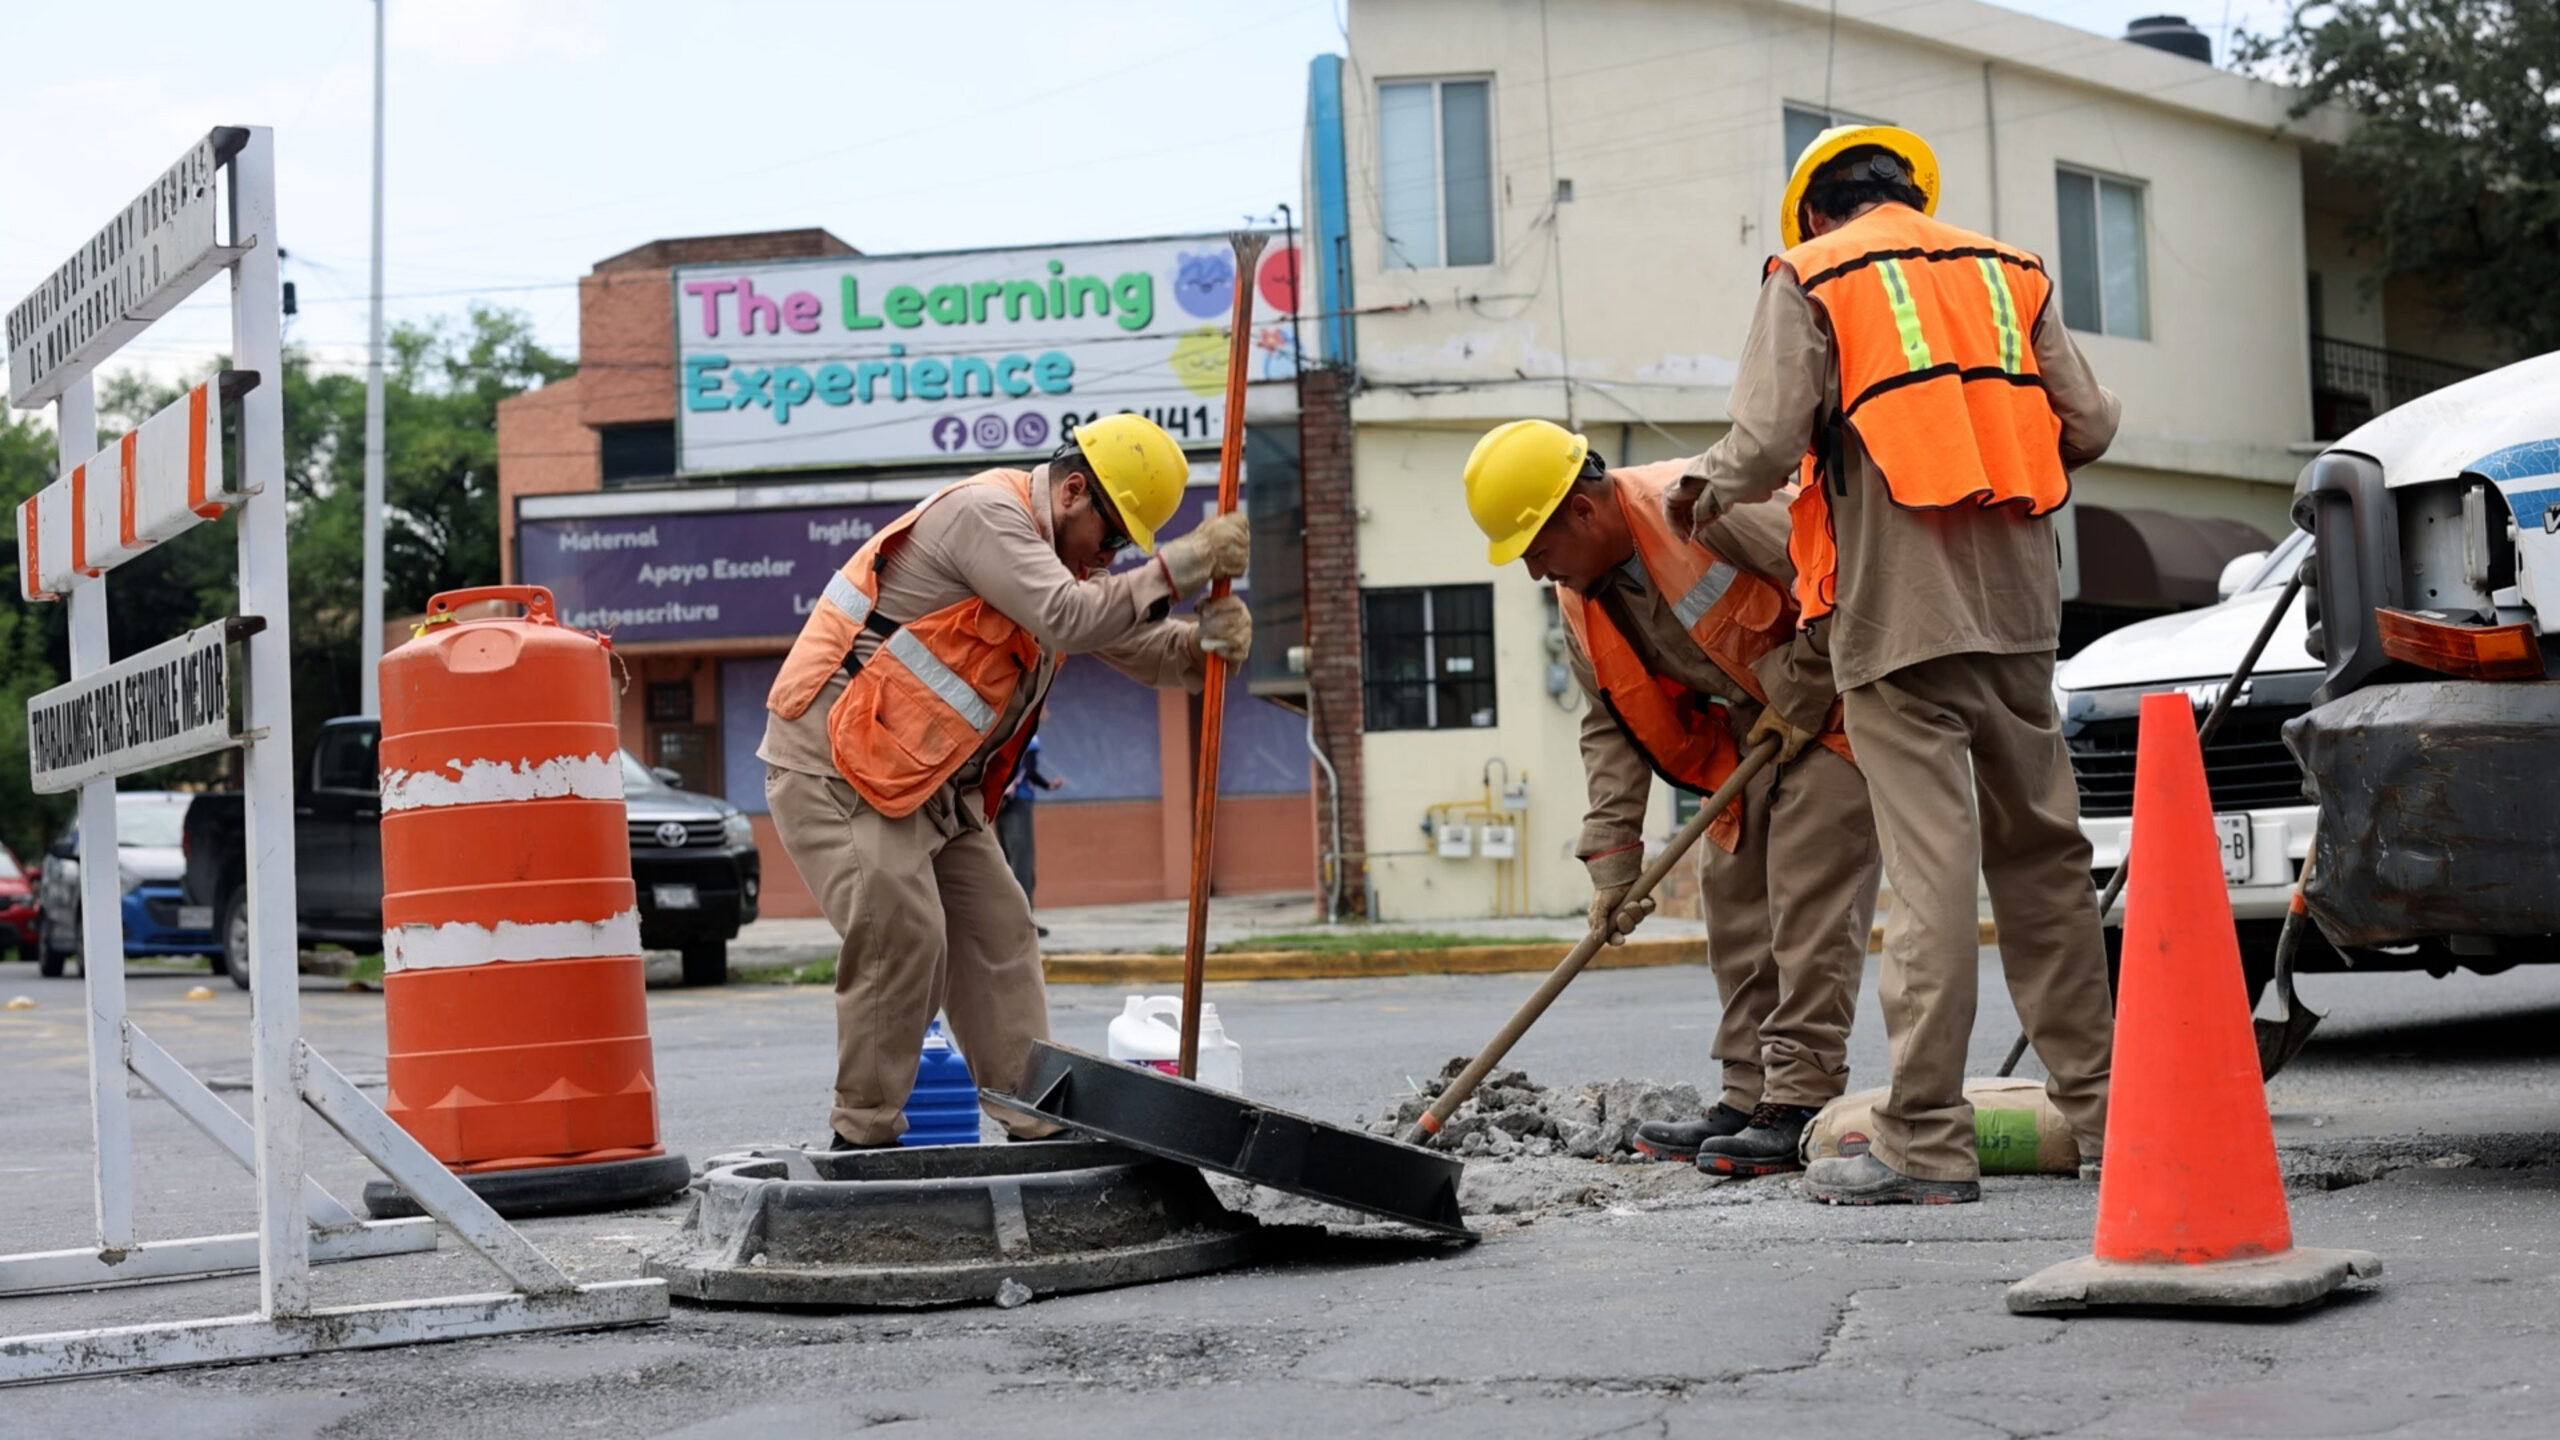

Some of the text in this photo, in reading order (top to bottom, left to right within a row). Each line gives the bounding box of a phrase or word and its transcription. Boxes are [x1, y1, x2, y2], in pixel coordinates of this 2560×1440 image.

[684, 260, 1154, 336] The Learning
[30, 341, 43, 385] DE
[684, 344, 1075, 424] Experience
[559, 526, 659, 551] Maternal
[808, 518, 874, 546] Inglés
[638, 557, 796, 587] Apoyo Escolar
[561, 602, 719, 629] Lectoescritura
[32, 642, 224, 774] TRABAJAMOS PARA SERVIRLE MEJOR
